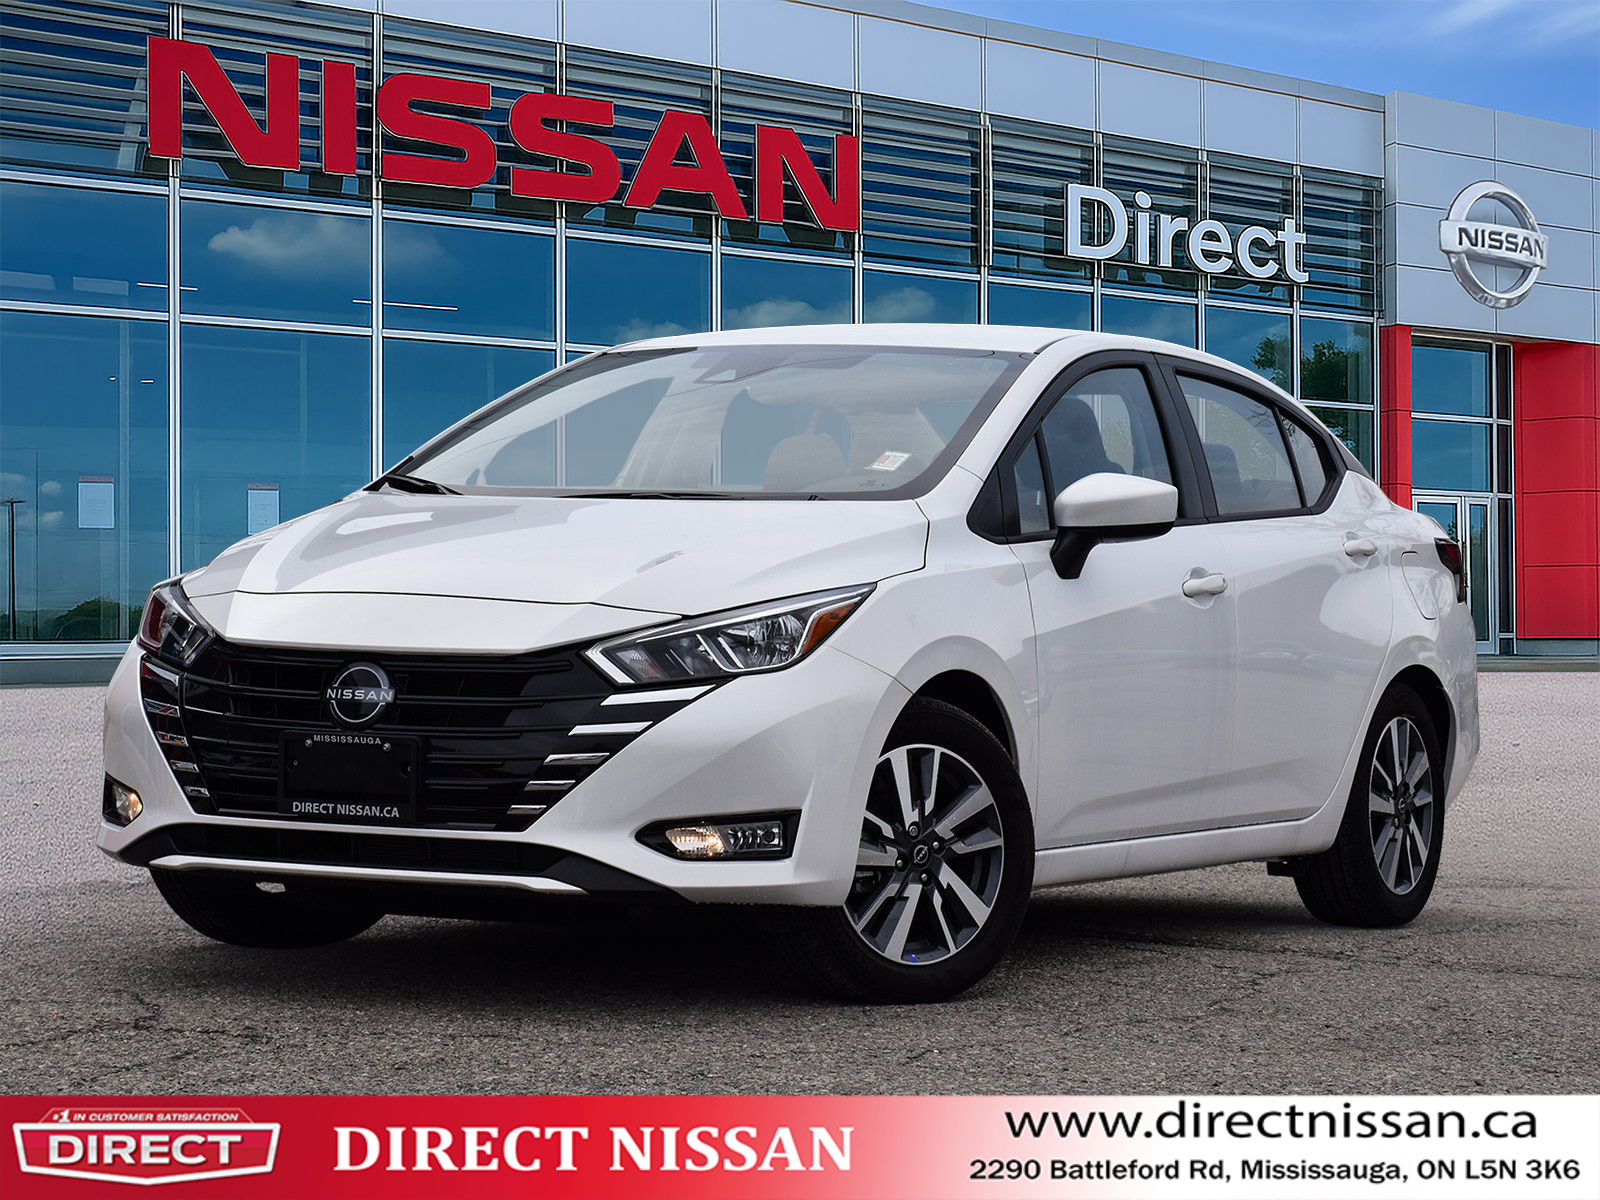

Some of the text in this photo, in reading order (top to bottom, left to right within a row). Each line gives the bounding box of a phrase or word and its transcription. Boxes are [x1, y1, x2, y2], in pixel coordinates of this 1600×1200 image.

[147, 37, 861, 232] NISSAN
[1064, 182, 1310, 285] Direct
[1457, 226, 1545, 260] NISSAN
[326, 688, 392, 701] NISSAN
[313, 734, 382, 744] MISSISSAUGA
[292, 802, 400, 817] DIRECT NISSAN.CA
